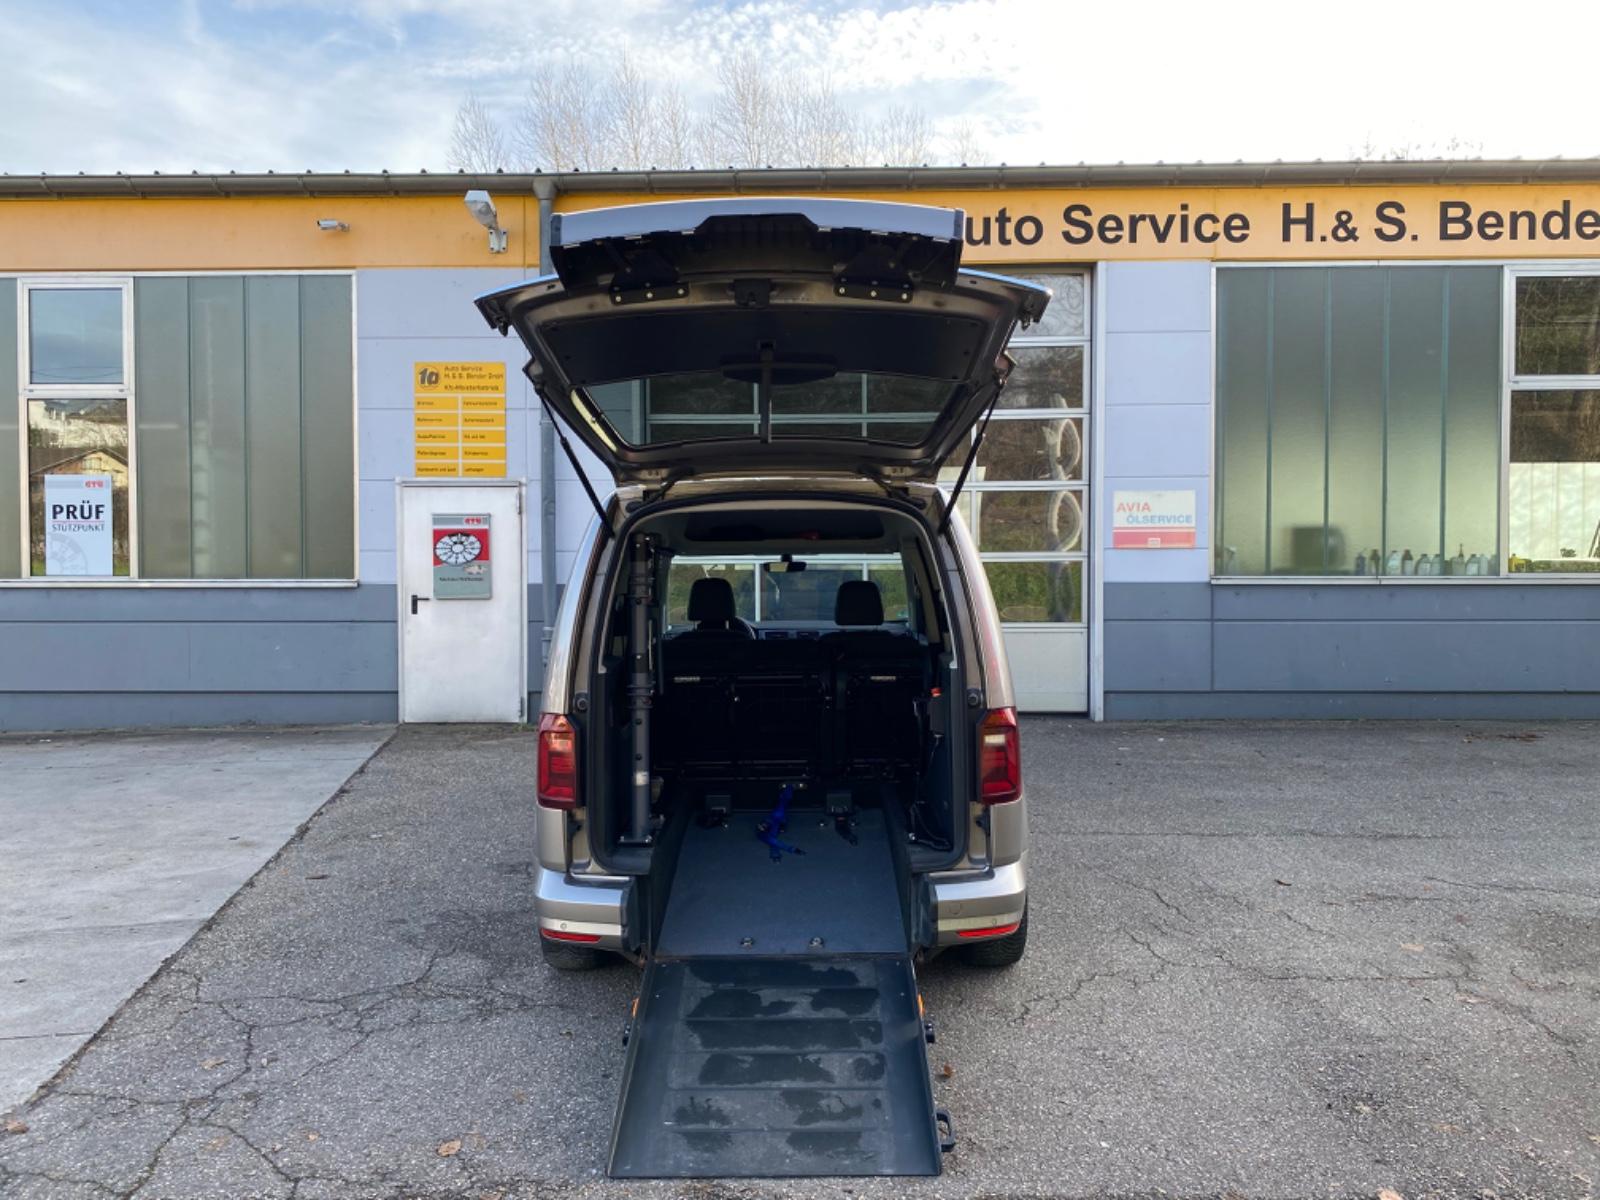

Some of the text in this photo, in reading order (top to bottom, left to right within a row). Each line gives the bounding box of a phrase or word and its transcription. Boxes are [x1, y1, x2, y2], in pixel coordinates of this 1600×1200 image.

[965, 207, 1044, 246] uto
[1061, 203, 1250, 244] Service
[1374, 200, 1418, 242] S.
[1439, 199, 1600, 241] Bende
[52, 499, 105, 520] PRÜF
[1116, 502, 1152, 513] AVIA
[1126, 513, 1193, 524] ÖLSERVICE
[52, 523, 105, 532] STÜTZPUNKT
